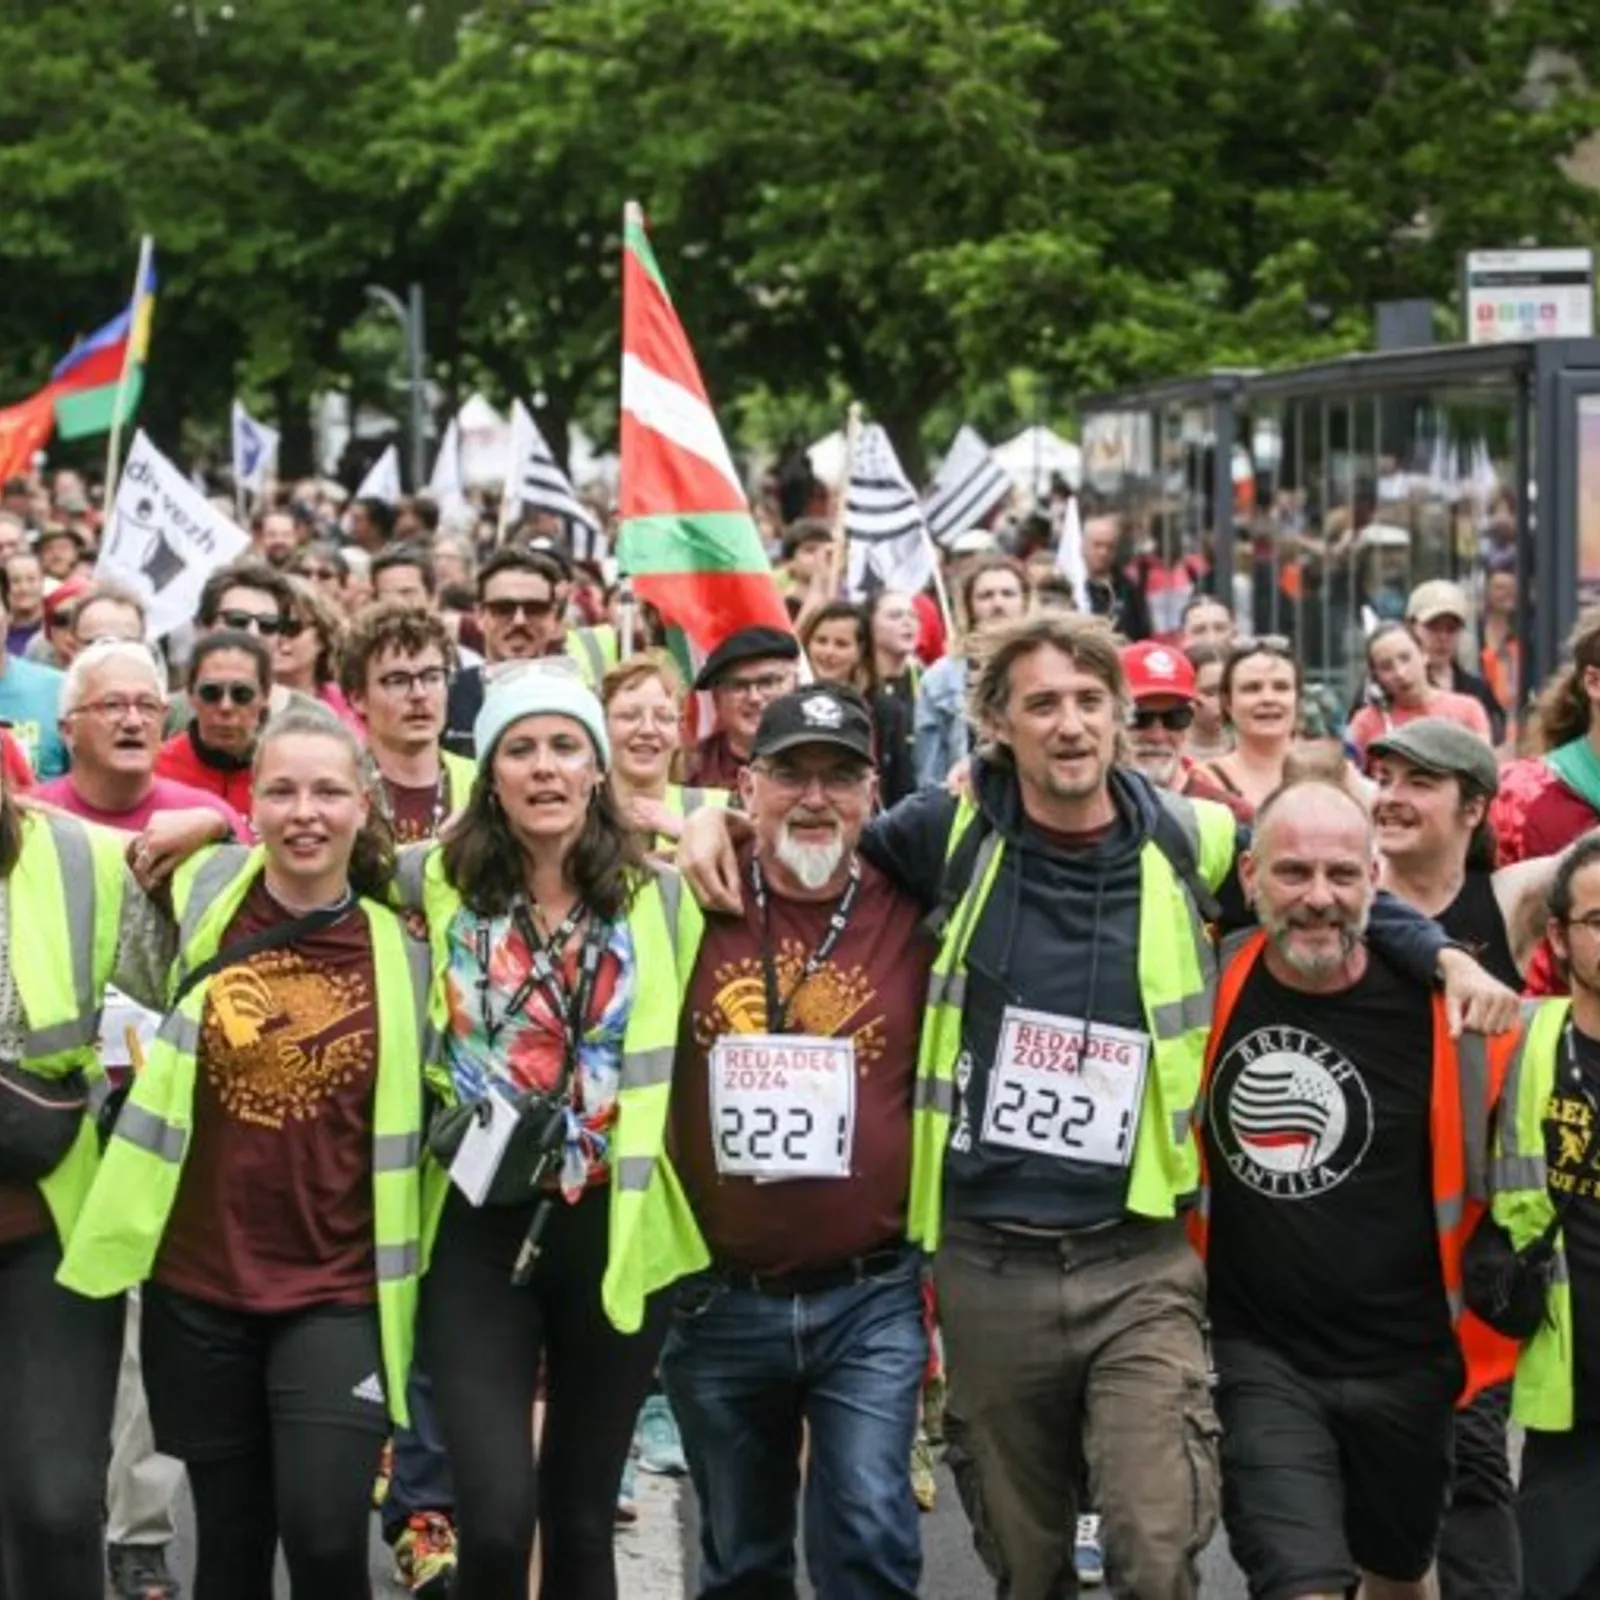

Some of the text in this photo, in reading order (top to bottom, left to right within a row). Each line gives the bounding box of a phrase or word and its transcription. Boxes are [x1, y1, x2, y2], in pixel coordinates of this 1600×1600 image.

[1012, 1045, 1077, 1075] 2024
[1016, 1025, 1131, 1066] REDADEG
[1236, 1028, 1355, 1084] BREIZH
[724, 1071, 788, 1090] 2024
[720, 1107, 846, 1160] 2221
[991, 1079, 1130, 1151] 2221
[1227, 1152, 1339, 1195] ANTIFA
